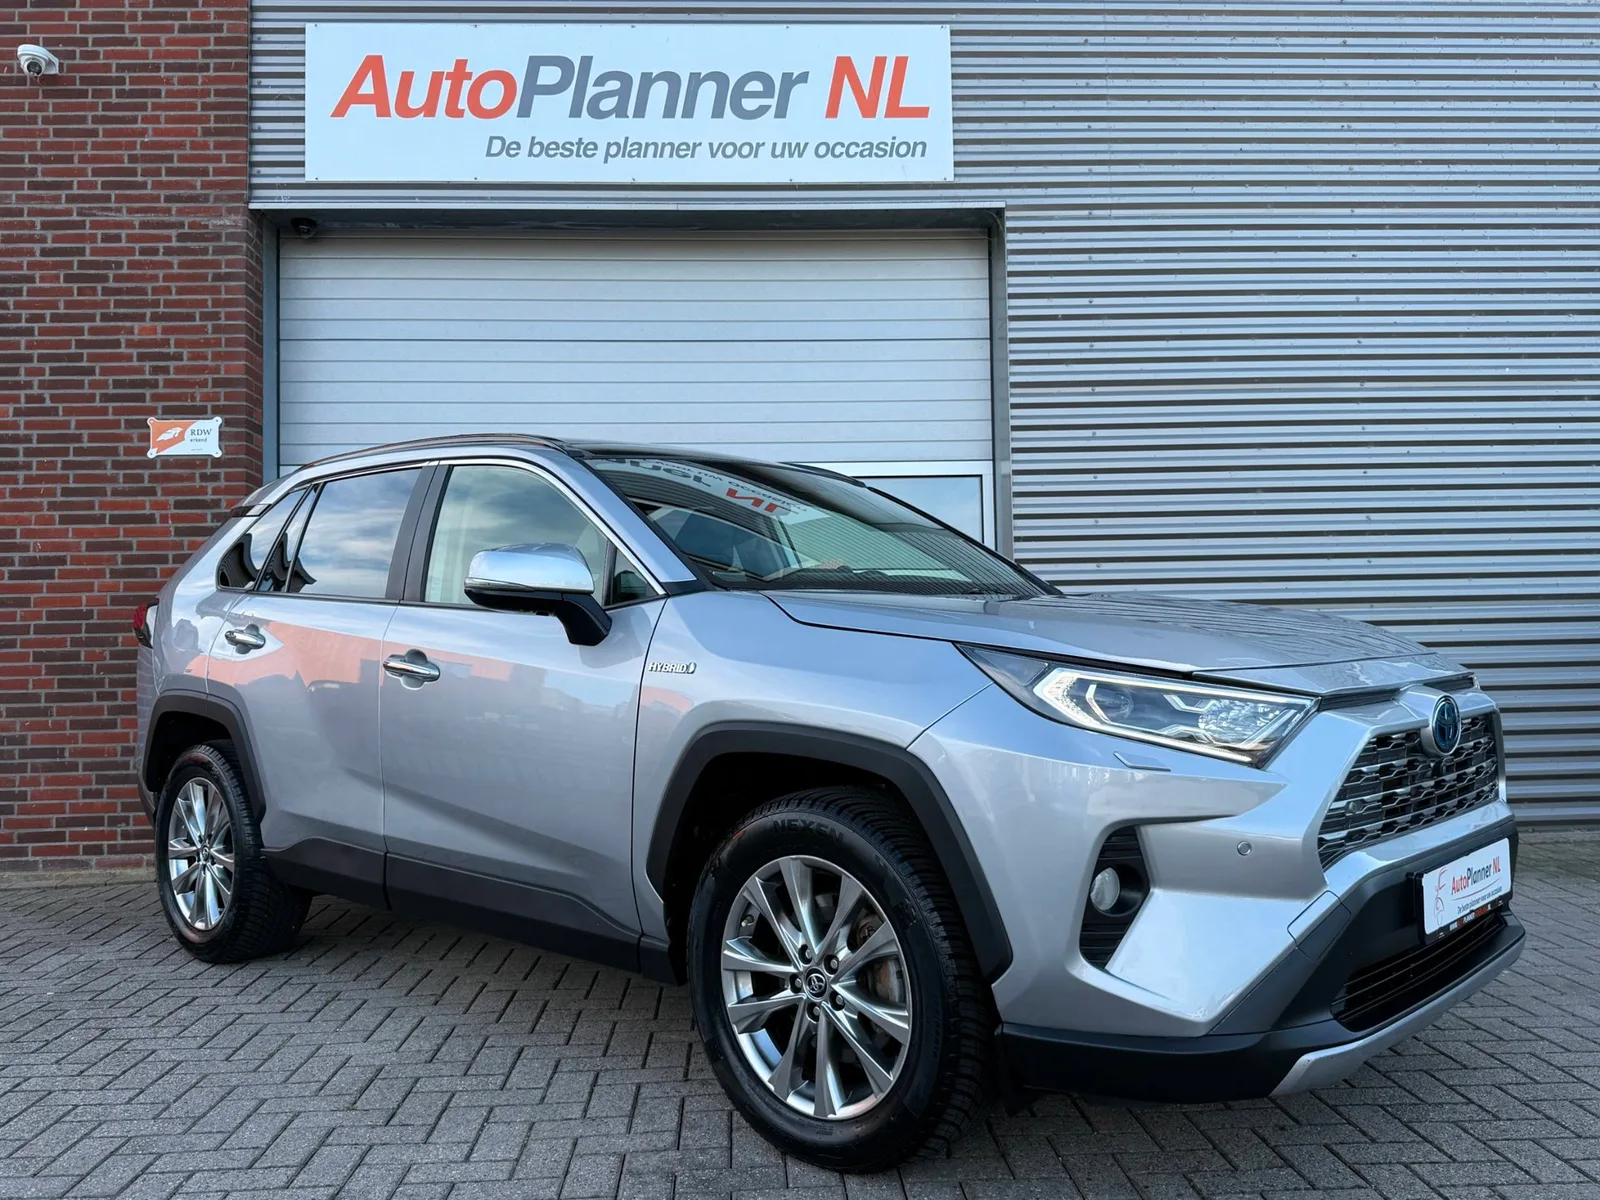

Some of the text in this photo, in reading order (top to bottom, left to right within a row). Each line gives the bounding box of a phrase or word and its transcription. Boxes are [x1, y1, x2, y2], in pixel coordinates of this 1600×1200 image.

[330, 54, 930, 120] AutoPlanner NL
[485, 135, 928, 165] De beste planner voor uw occasion
[190, 428, 212, 436] RDW
[648, 661, 688, 674] HYBRID
[772, 818, 844, 843] NEXEN
[1451, 856, 1501, 895] AutoPlanner NL
